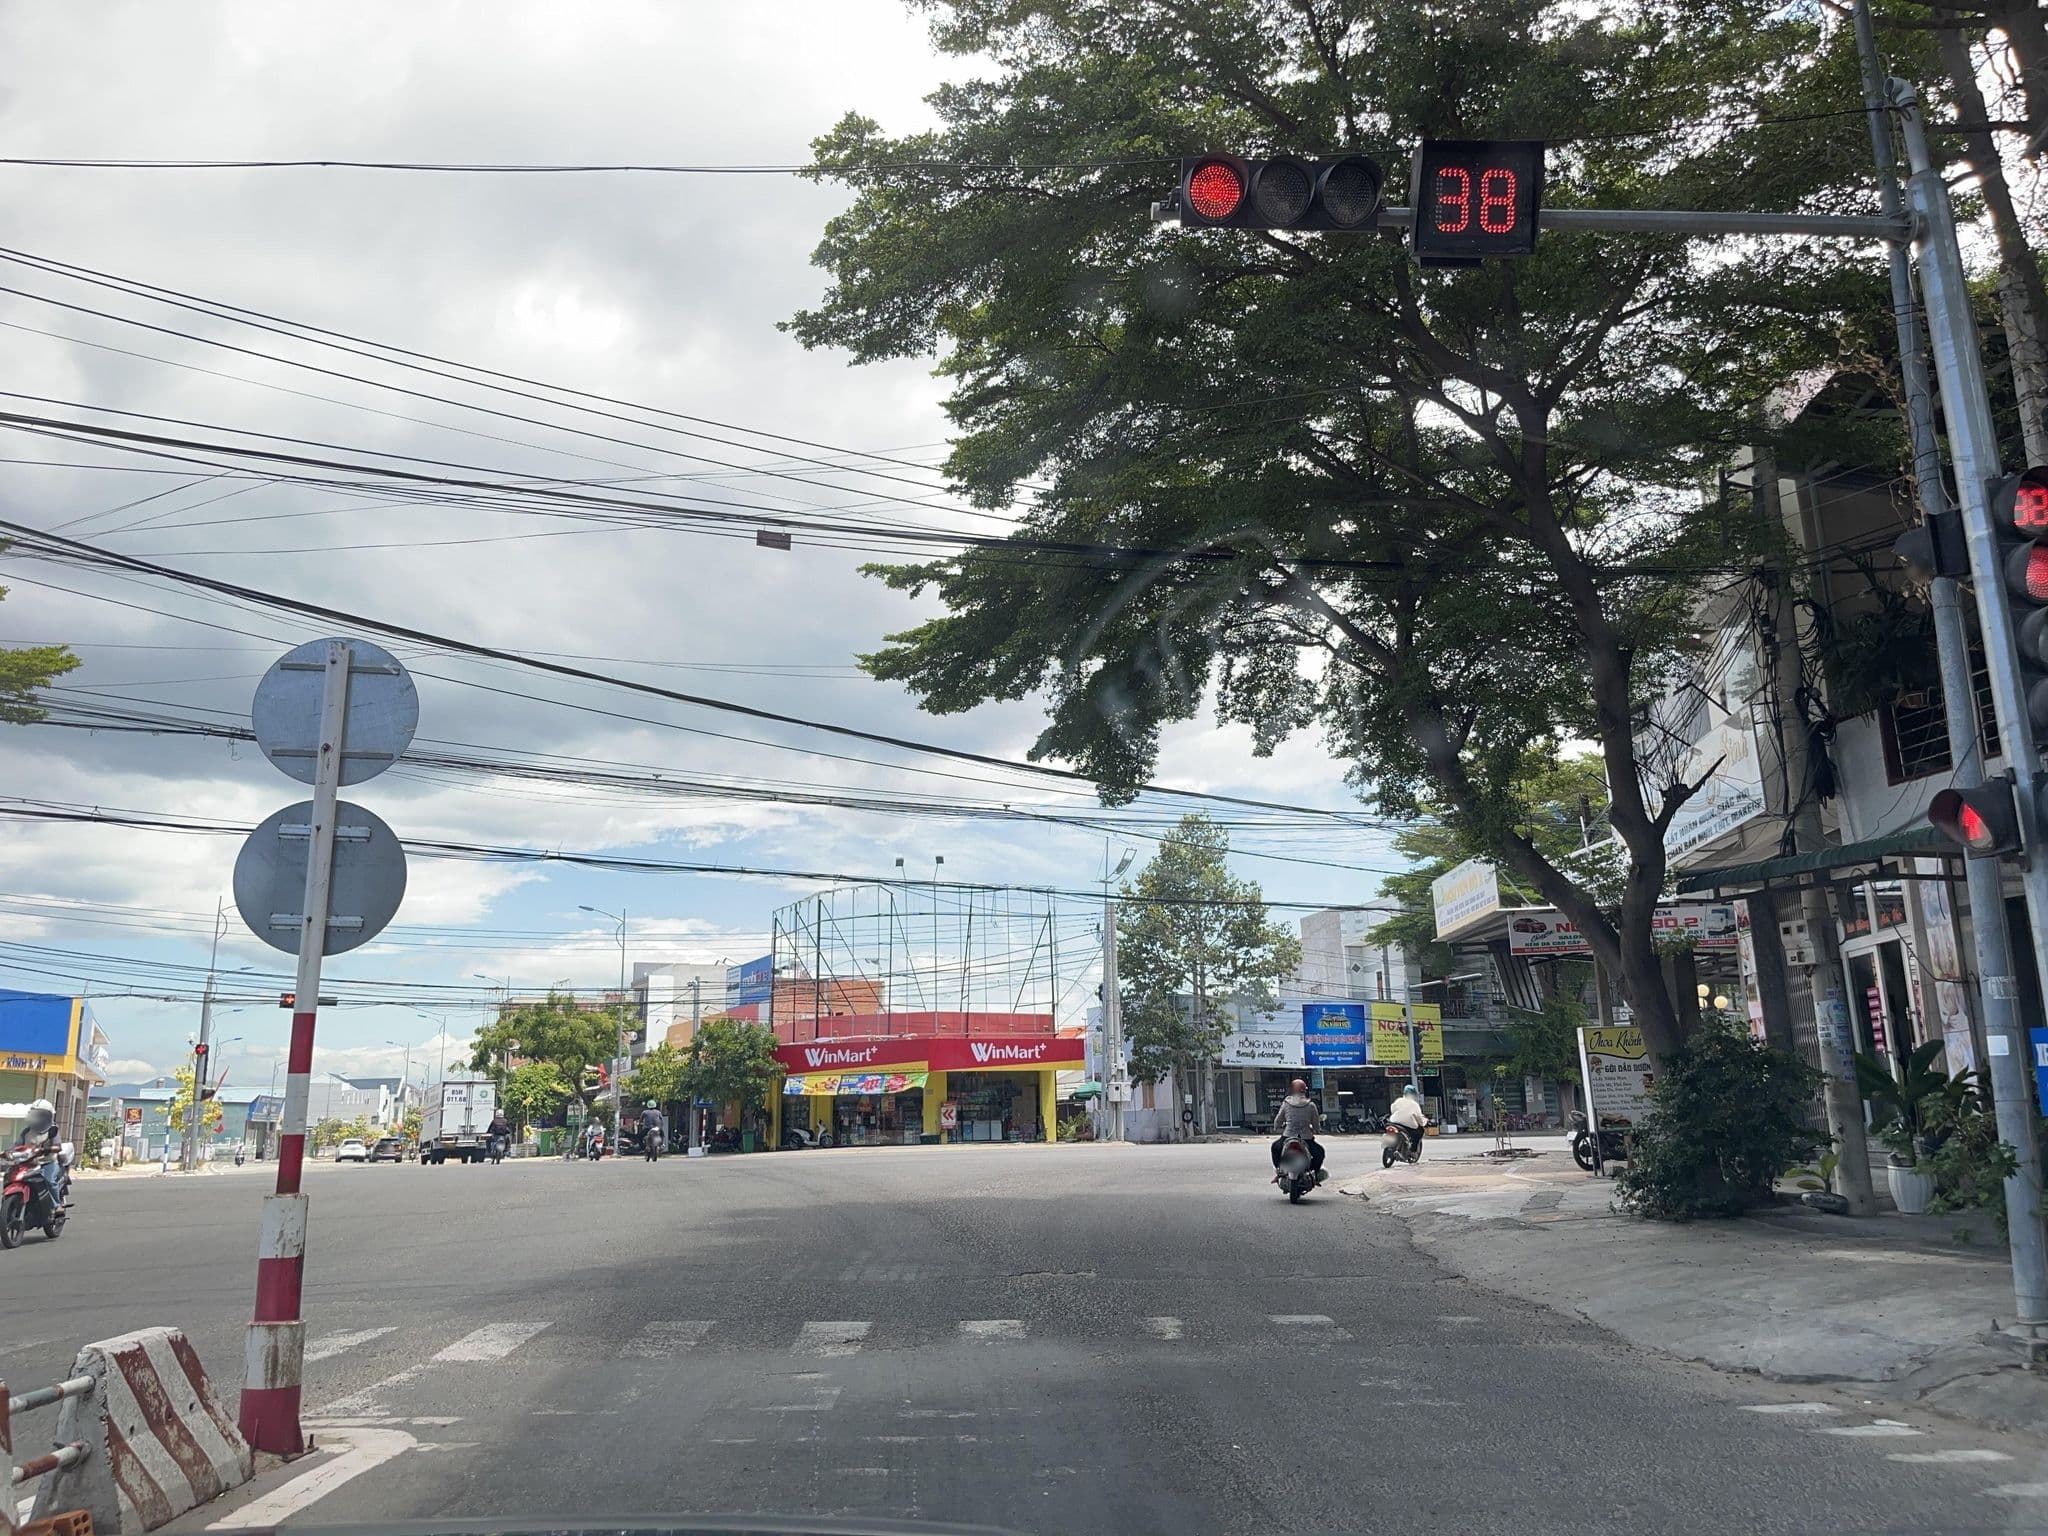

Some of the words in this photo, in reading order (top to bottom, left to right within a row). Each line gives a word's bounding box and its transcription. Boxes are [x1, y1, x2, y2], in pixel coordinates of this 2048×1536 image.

[1437, 167, 1517, 233] 38
[1377, 1016, 1407, 1032] NGÂ
[1262, 1040, 1284, 1049] KHOA
